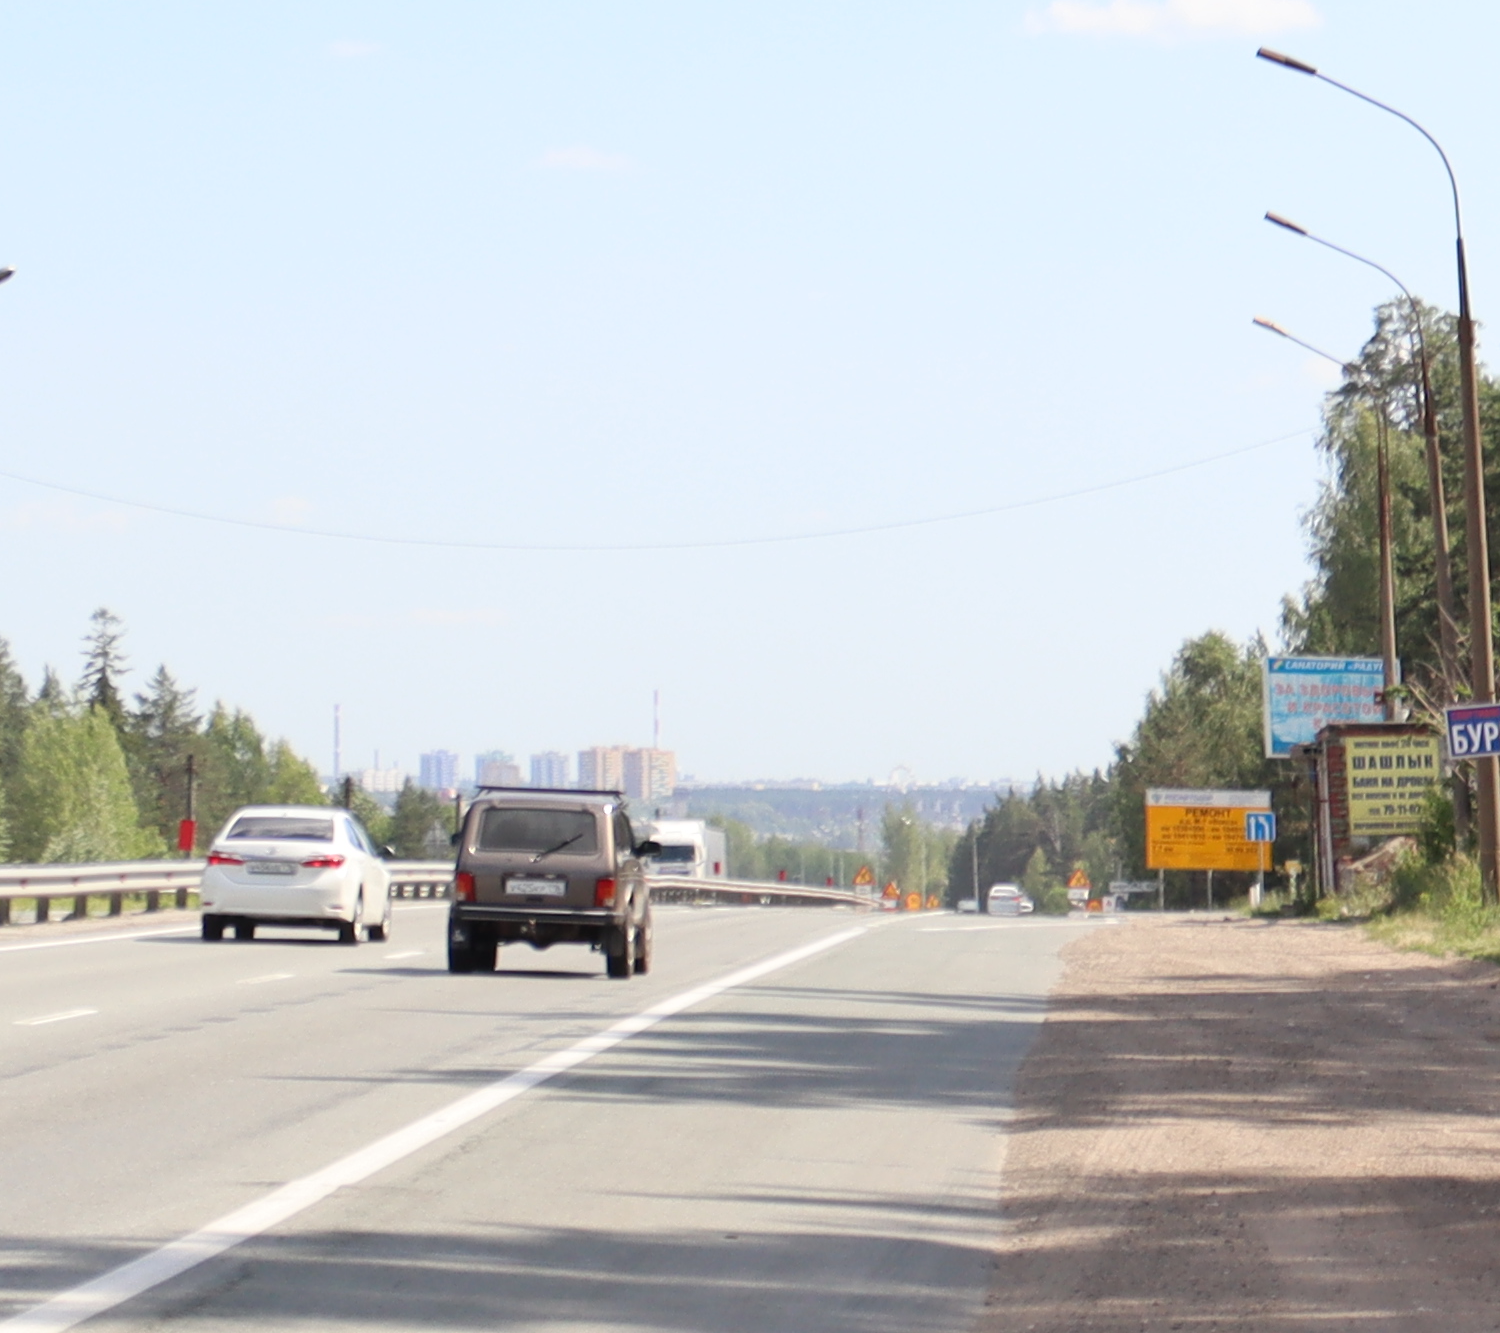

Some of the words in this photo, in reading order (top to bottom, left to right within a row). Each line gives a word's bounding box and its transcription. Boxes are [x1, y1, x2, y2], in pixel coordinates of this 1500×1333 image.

[1285, 660, 1346, 671] САНАТОРИЙ
[1352, 755, 1433, 770] ШАШЛЫК
[1185, 808, 1232, 818] РЕМОНТ
